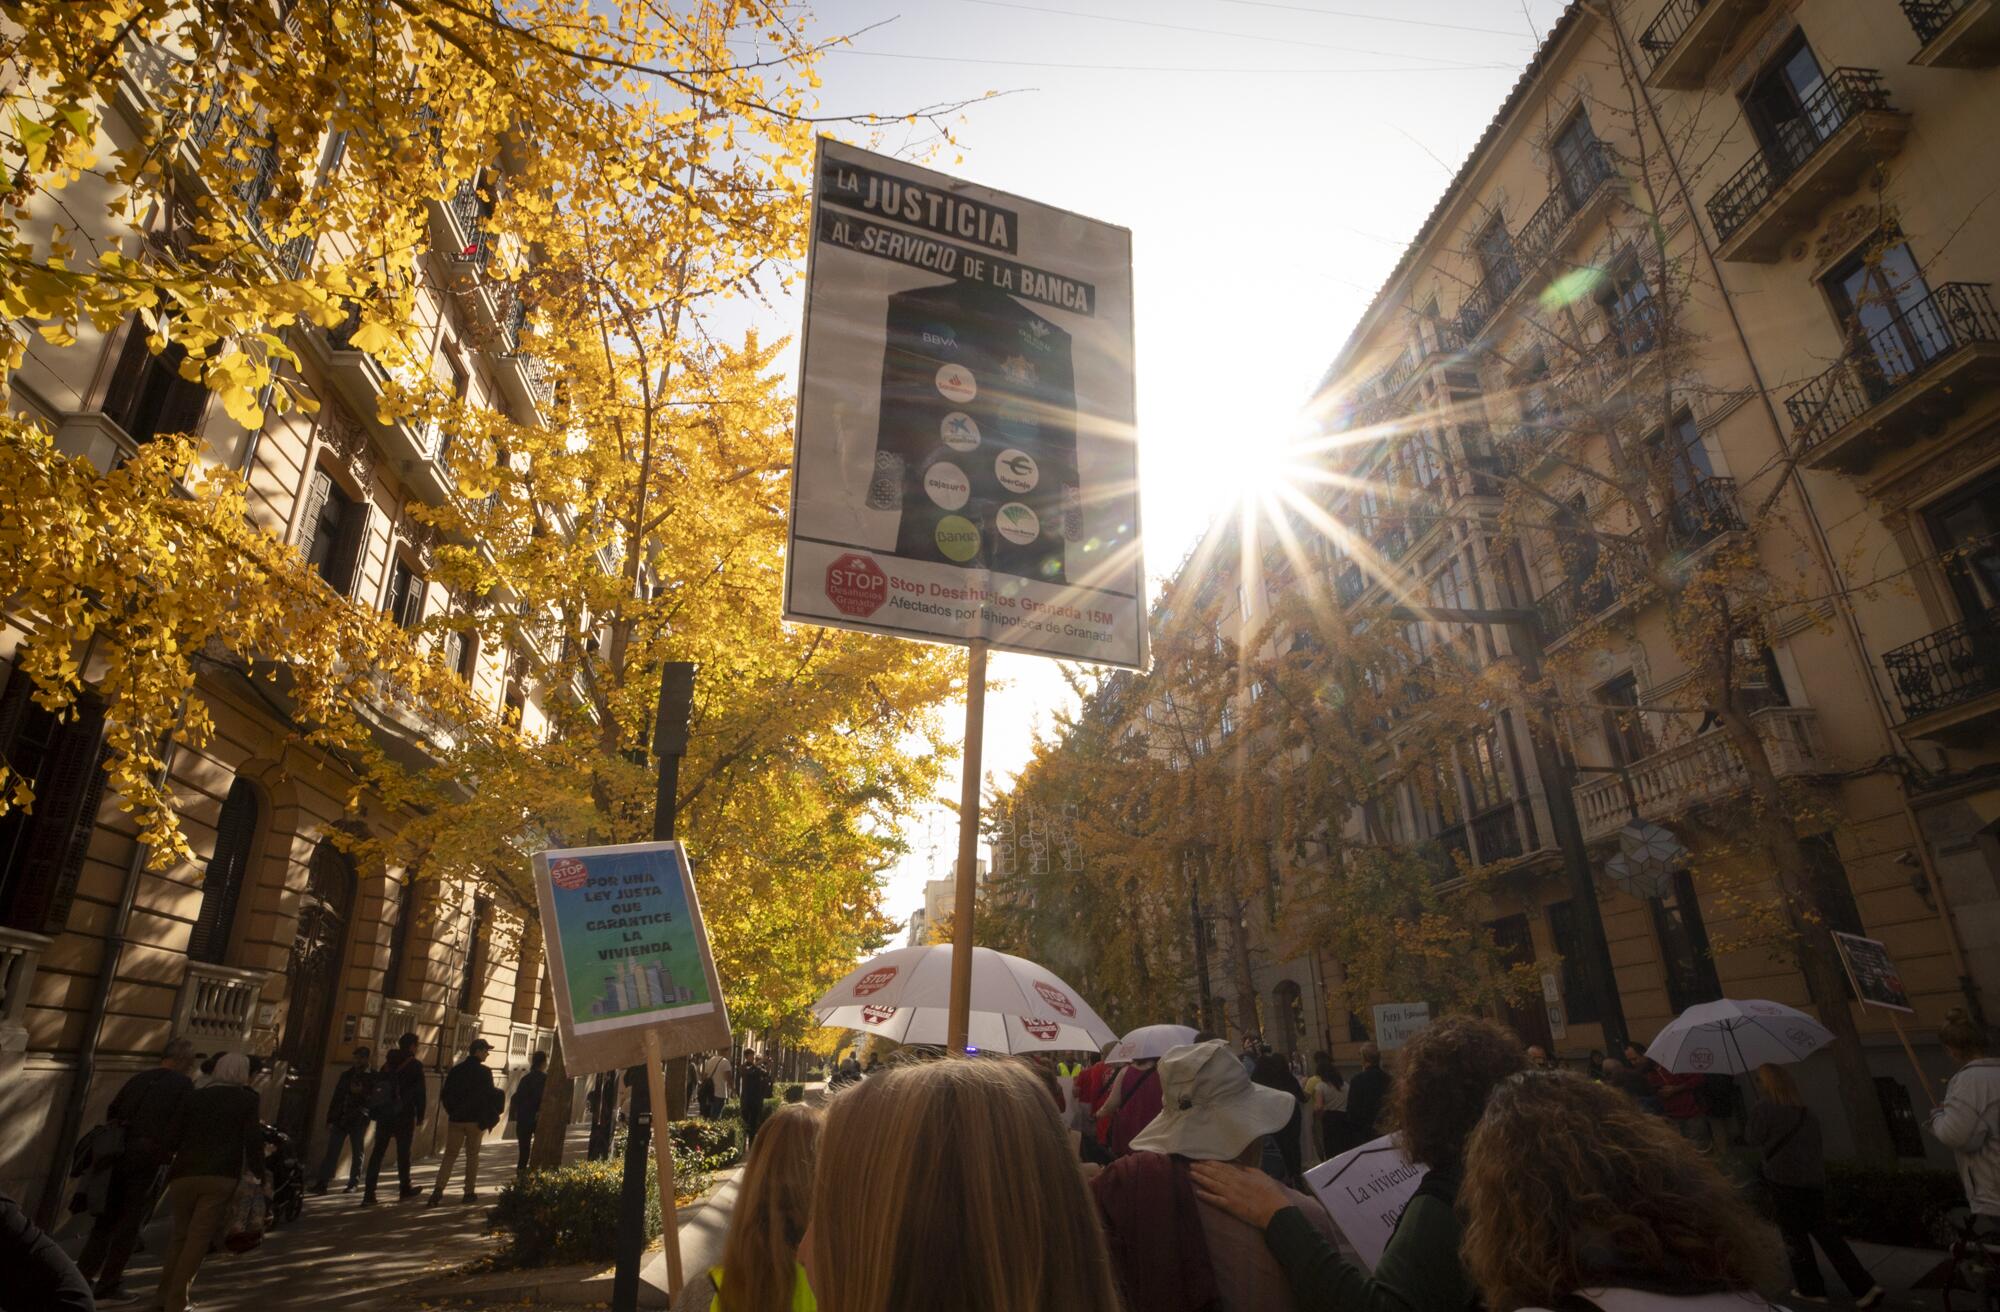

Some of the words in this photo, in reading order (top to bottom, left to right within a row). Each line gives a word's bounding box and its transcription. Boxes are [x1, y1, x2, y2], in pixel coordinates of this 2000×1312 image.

[837, 168, 860, 193] LA
[864, 177, 1008, 249] JUSTICIA
[832, 221, 855, 247] AL
[861, 226, 957, 273] SERVICIO
[963, 255, 985, 281] DE
[993, 265, 1013, 290] LA
[1020, 268, 1089, 312] BANCA
[923, 332, 959, 350] BBVA
[831, 569, 884, 591] STOP
[890, 576, 925, 597] Stop
[1021, 598, 1081, 620] Granada
[1086, 609, 1114, 625] 15M
[889, 596, 952, 617] Afectados
[955, 608, 977, 621] por
[1045, 621, 1061, 634] de
[1063, 625, 1113, 642] Granada
[553, 864, 584, 879] STOP
[586, 876, 619, 888] POR
[622, 873, 655, 885] UNA
[584, 891, 612, 902] LEY
[616, 886, 663, 899] JUSTA
[611, 902, 643, 915] QUE
[586, 912, 673, 931] GARANTICE
[622, 931, 643, 942] LA
[597, 942, 673, 960] VIVIENDA
[863, 973, 895, 985] STOP
[1346, 1186, 1370, 1204] La
[1368, 1160, 1419, 1194] vivienda
[1381, 1209, 1398, 1228] no
